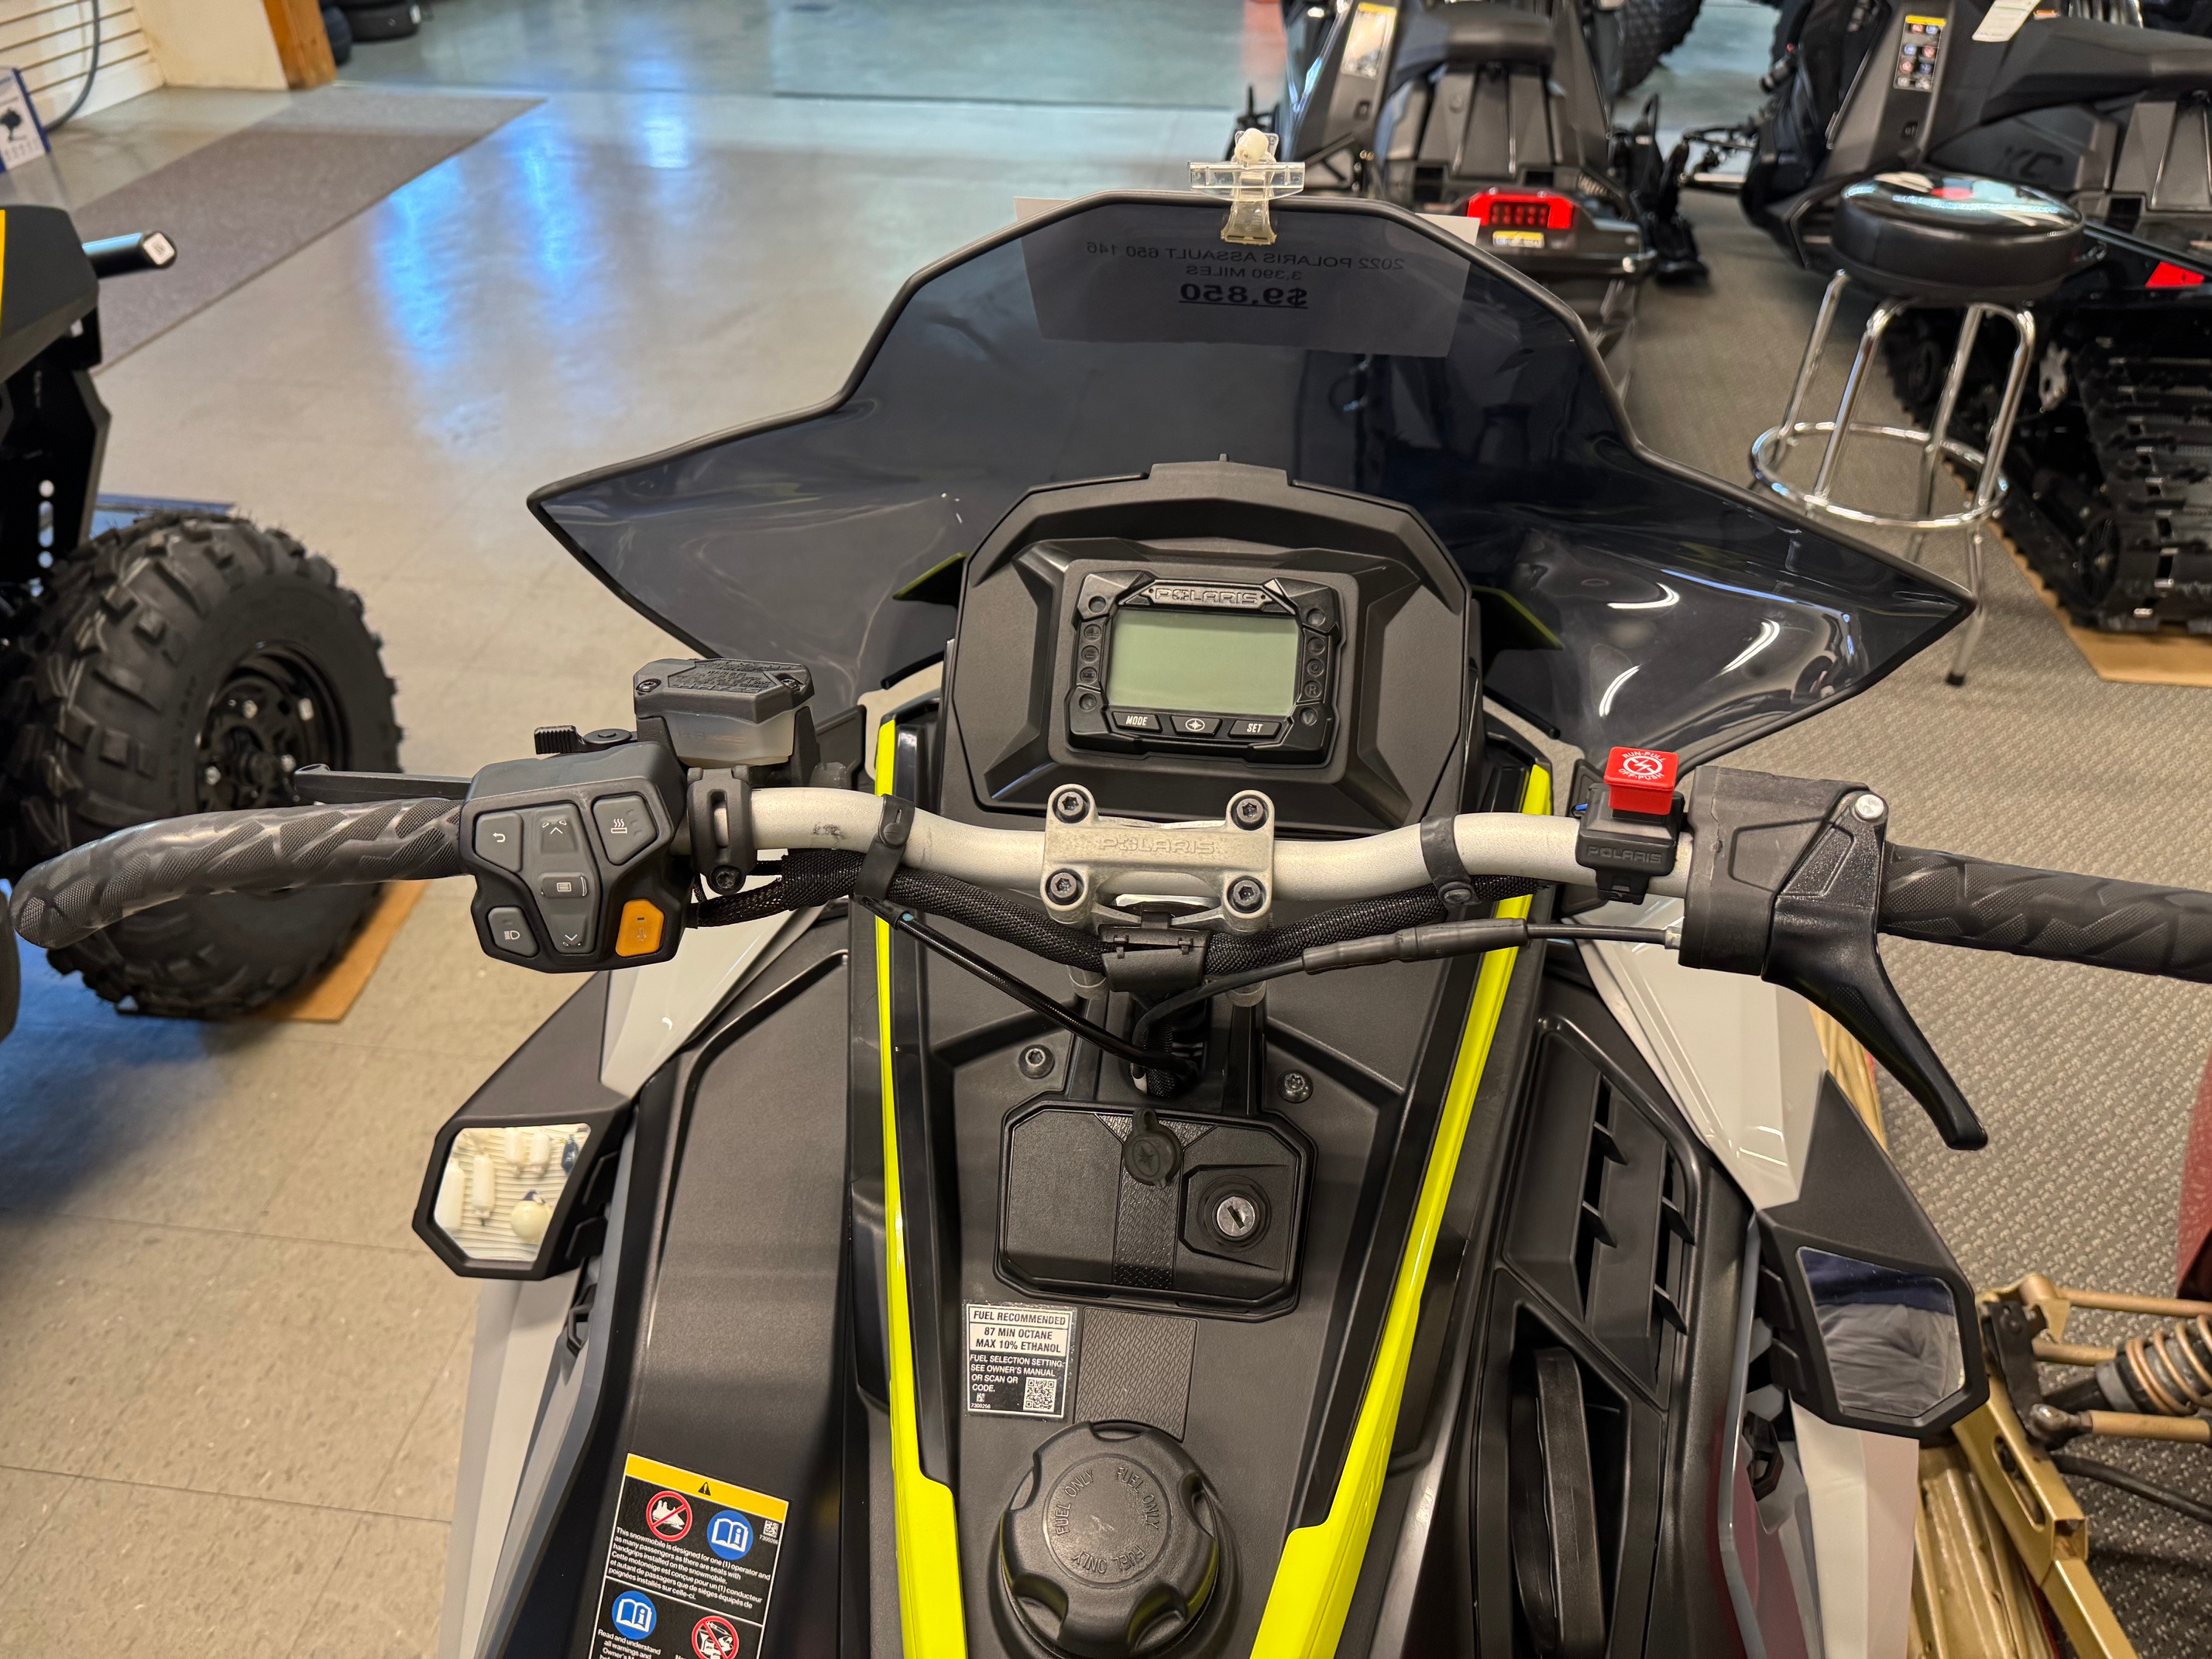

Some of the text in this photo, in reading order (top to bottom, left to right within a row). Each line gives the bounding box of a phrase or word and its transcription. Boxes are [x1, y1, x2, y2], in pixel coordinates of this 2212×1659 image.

[1155, 587, 1259, 605] POLARIS
[1125, 715, 1148, 726] MODE
[1246, 723, 1263, 733] SET
[1099, 837, 1216, 855] POLARIS
[1587, 845, 1662, 864] POLARIS
[974, 1310, 1066, 1325] FUEL RECOMMENDED
[984, 1327, 1053, 1340] 87 MIN OCTANE
[975, 1338, 1061, 1353] MAX 10% ETHANOL
[970, 1354, 1065, 1368] FUEL SELECTION SETTING:
[984, 1375, 1005, 1383] SCAN
[1006, 1376, 1018, 1384] QR
[986, 1365, 1022, 1374] OWNER'S
[1023, 1367, 1056, 1377] MANUAL
[971, 1383, 995, 1392] CODE.
[1055, 1468, 1094, 1537] FUEL ONLY
[1115, 1466, 1160, 1530] FUEL ONLY
[616, 1527, 629, 1536] This
[629, 1532, 665, 1547] snowmobile
[672, 1544, 700, 1558] designed
[722, 1560, 730, 1569] (1)
[730, 1564, 757, 1575] operator
[623, 1539, 638, 1549] many
[639, 1544, 674, 1558] passengers
[682, 1557, 699, 1566] there
[710, 1566, 726, 1575] seats
[613, 1543, 643, 1558] handgrips
[643, 1552, 669, 1565] installed
[678, 1563, 688, 1571] the
[689, 1568, 726, 1584] snowmobile.
[1071, 1549, 1108, 1575] ONLY
[611, 1551, 627, 1561] Cette
[628, 1558, 660, 1571] motoneige
[671, 1571, 693, 1582] conçue
[694, 1578, 708, 1586] pour
[717, 1584, 726, 1592] (1)
[726, 1588, 762, 1602] conducteur
[617, 1562, 635, 1571] autant
[644, 1571, 676, 1585] passagers
[608, 1568, 636, 1580] poignées
[636, 1575, 661, 1589] installés
[672, 1588, 696, 1599] celle-ci.
[597, 1628, 661, 1656] Read and understand
[612, 1644, 639, 1657] warnings
[639, 1650, 652, 1659] and
